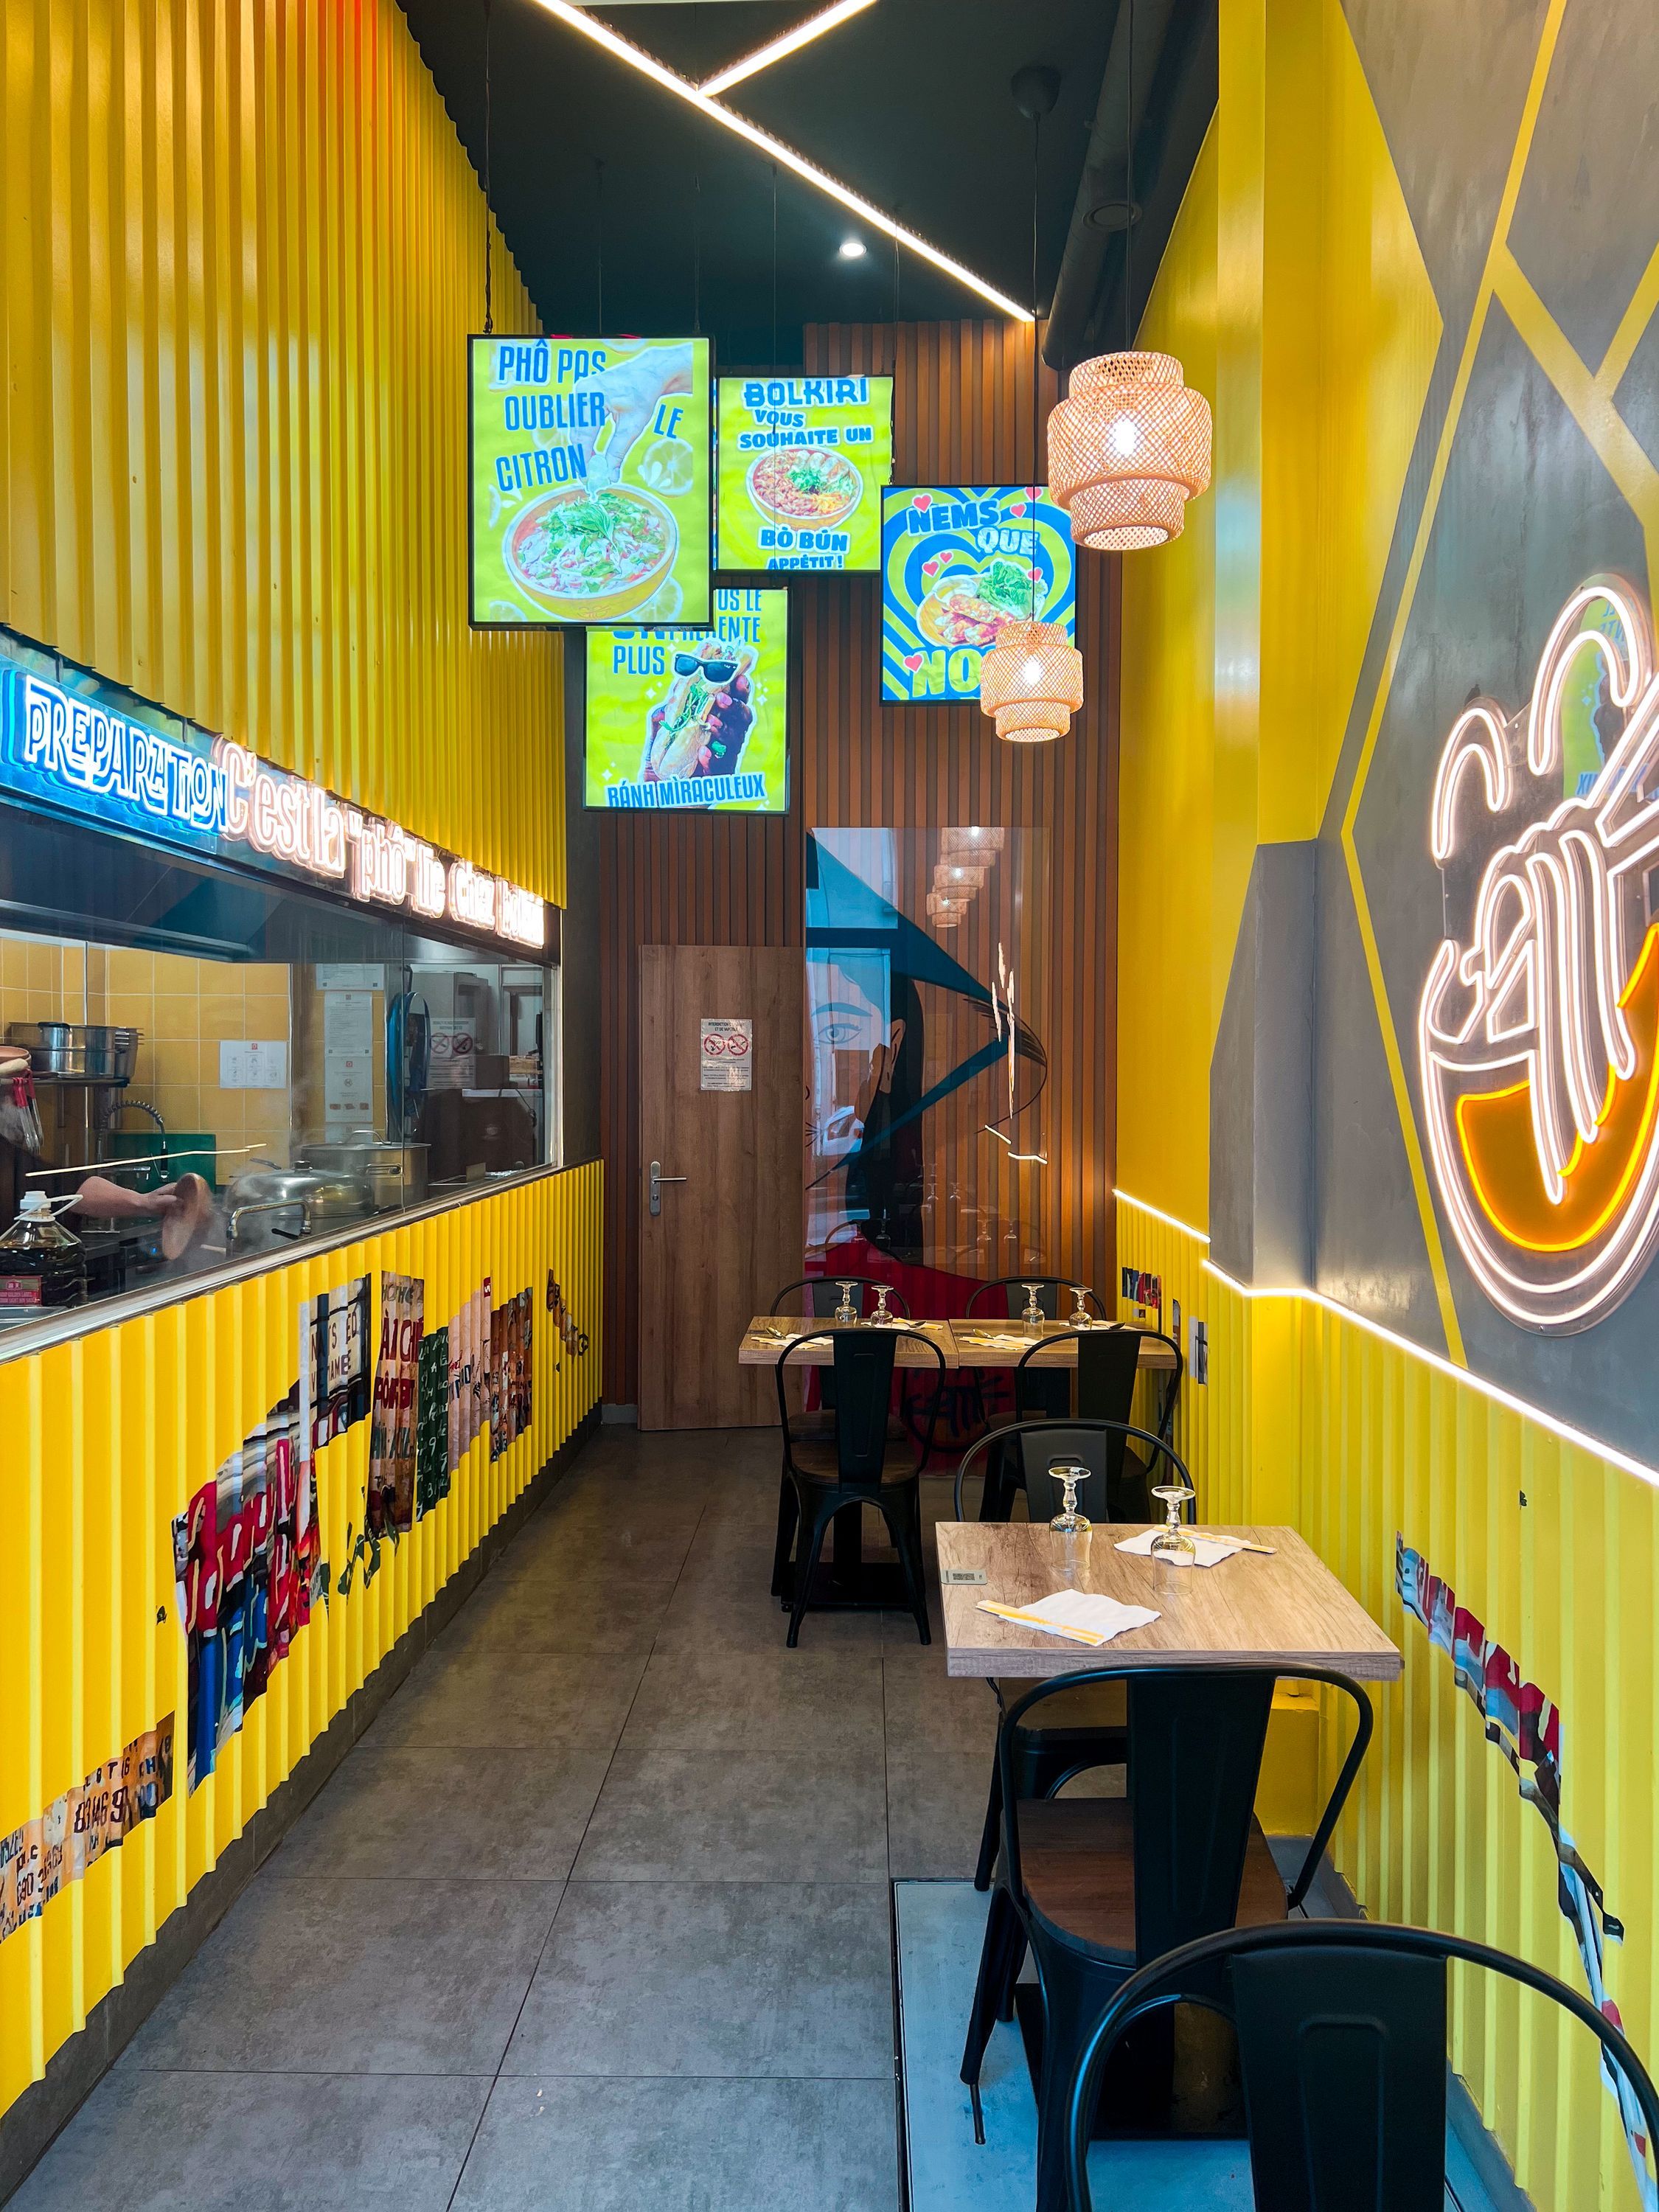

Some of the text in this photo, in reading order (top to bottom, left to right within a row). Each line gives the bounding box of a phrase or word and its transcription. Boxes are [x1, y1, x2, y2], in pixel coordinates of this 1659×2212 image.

[498, 339, 606, 383] PHÔ PAS
[744, 378, 868, 406] BOLKIRI
[505, 392, 684, 439] OUBLIER LE
[755, 409, 804, 427] VOUS
[740, 428, 872, 448] SOUHAITE UN
[495, 443, 587, 491] CITRON
[908, 501, 998, 535] NEMS
[761, 526, 848, 552] BÒ BÚN
[978, 528, 1039, 554] QUE
[746, 589, 762, 612] LE
[613, 645, 665, 675] PLUS
[24, 674, 229, 833] PREPARATION
[608, 780, 655, 807] BÁNH
